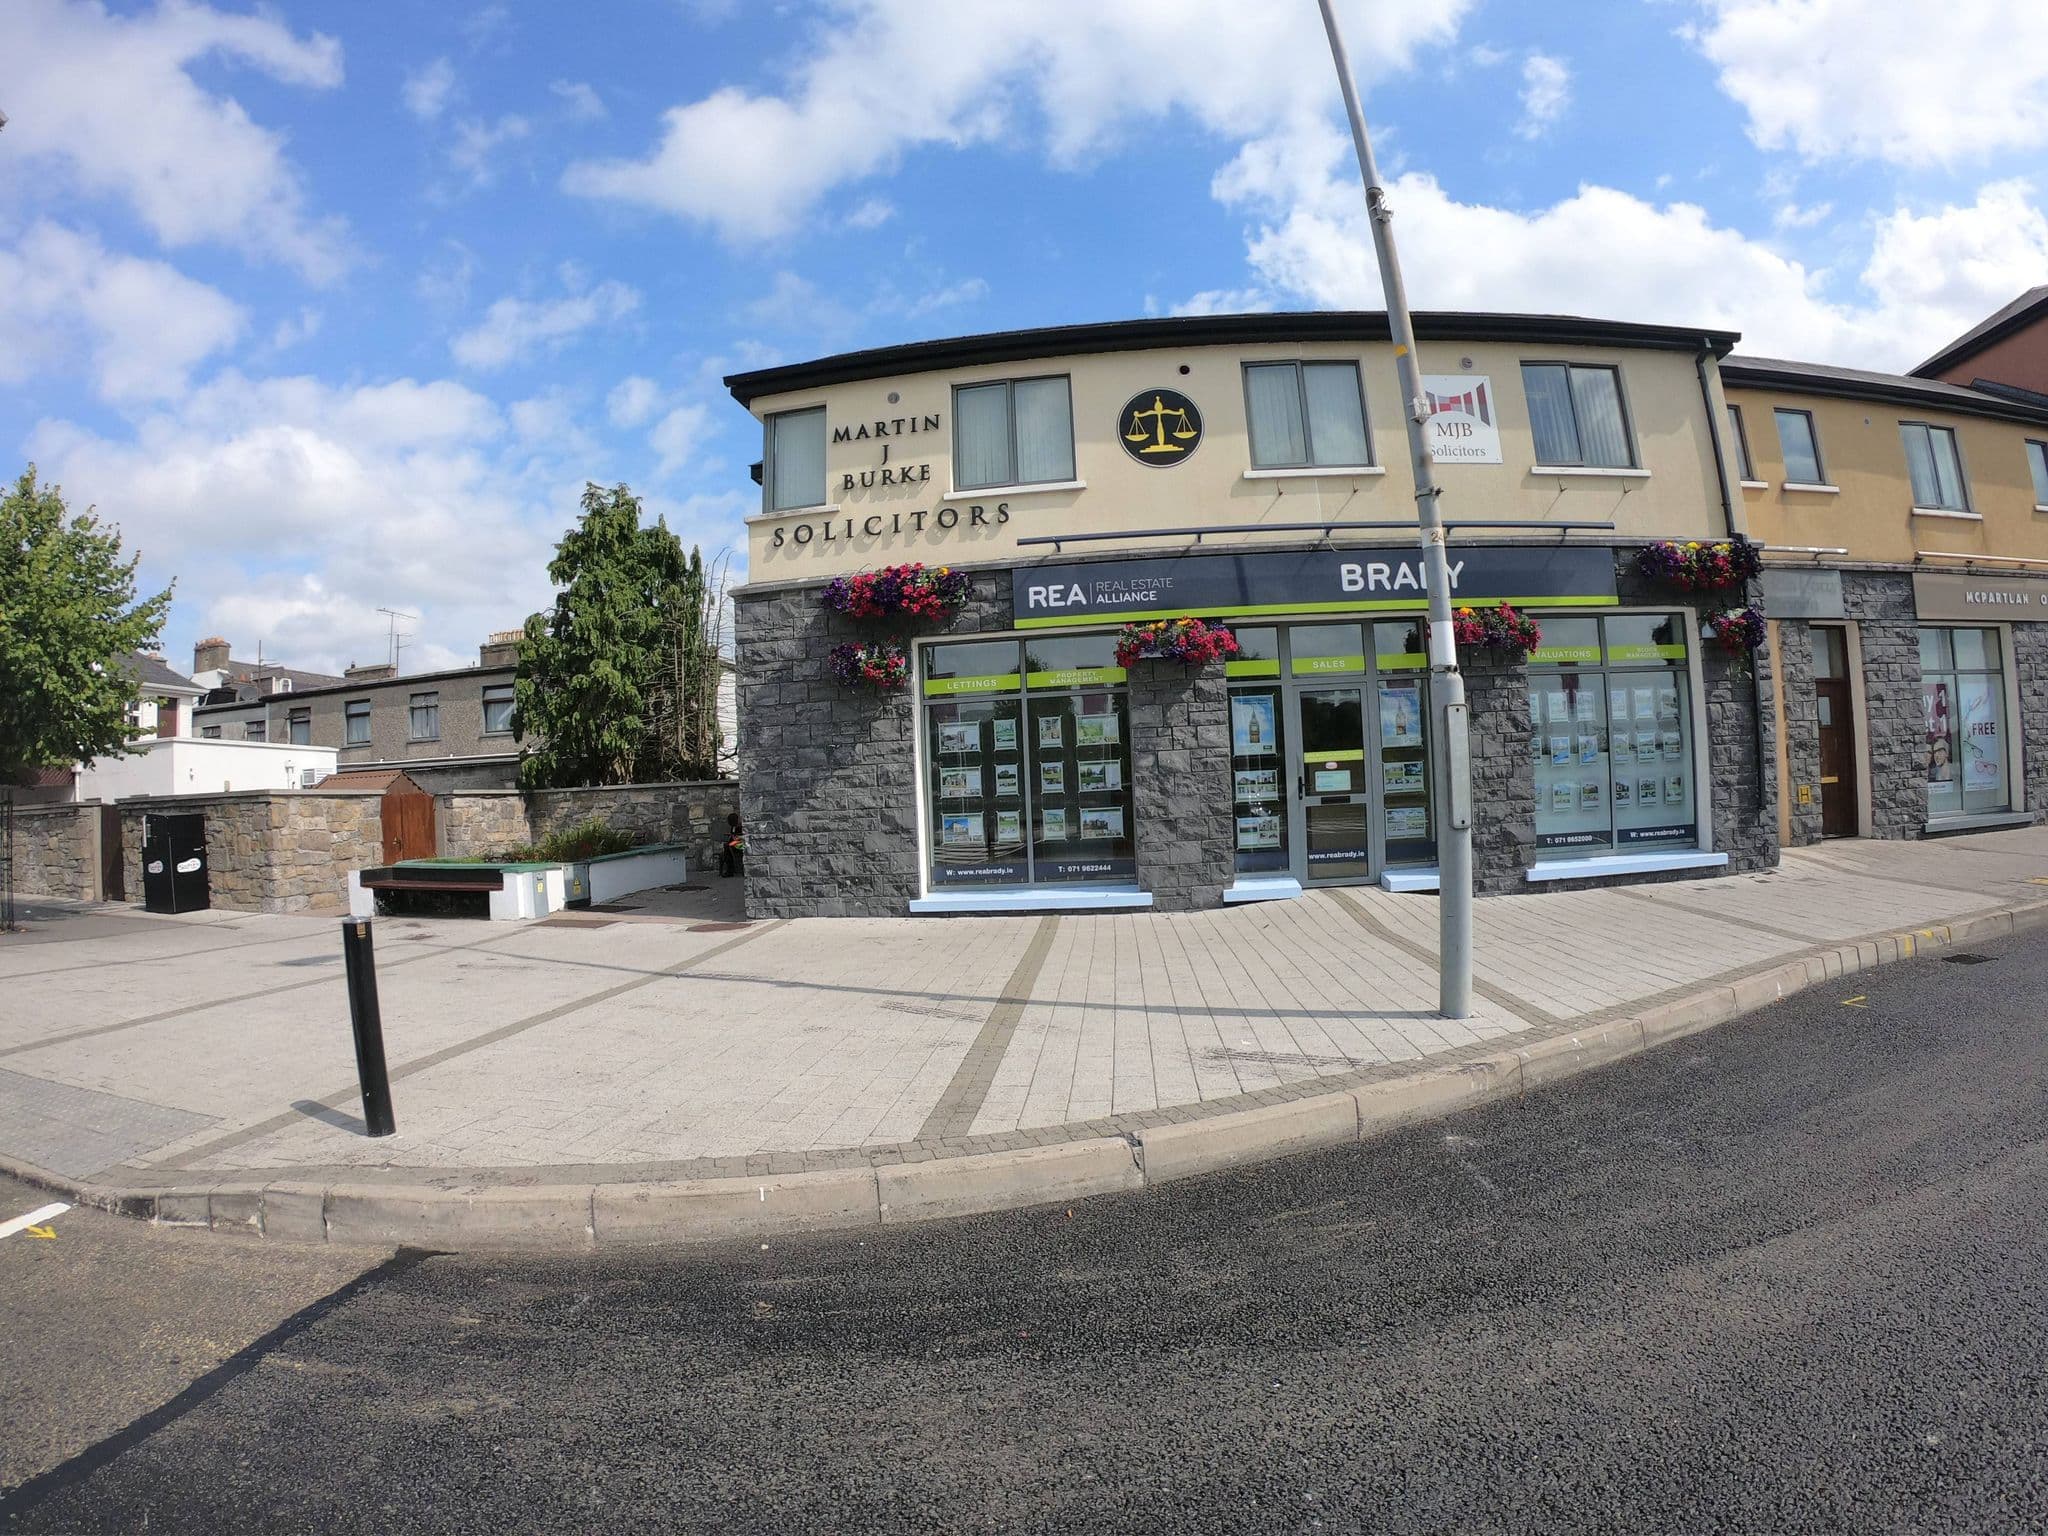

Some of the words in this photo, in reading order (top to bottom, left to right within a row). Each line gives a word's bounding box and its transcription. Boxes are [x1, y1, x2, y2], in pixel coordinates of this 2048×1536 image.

[832, 414, 940, 443] MARTIN
[1436, 422, 1473, 439] MJB
[881, 444, 890, 465] J
[843, 464, 931, 490] BURKE
[773, 503, 1010, 547] SOLICITORS
[1096, 580, 1128, 592] REAL
[1131, 577, 1174, 590] ESTATE
[1028, 583, 1088, 609] REA
[1095, 590, 1158, 604] ALLIANCE
[1966, 591, 2029, 605] MCPARTLAN
[1535, 650, 1591, 659] VALUATIONS
[1312, 659, 1345, 669] SALES
[946, 679, 998, 690] LETTINGS
[1049, 675, 1104, 685] MANAGEMENT
[1972, 722, 1996, 736] FREE
[1309, 850, 1365, 861] www.reabrady.ie
[1058, 865, 1066, 873] T:
[1067, 865, 1080, 873] 071
